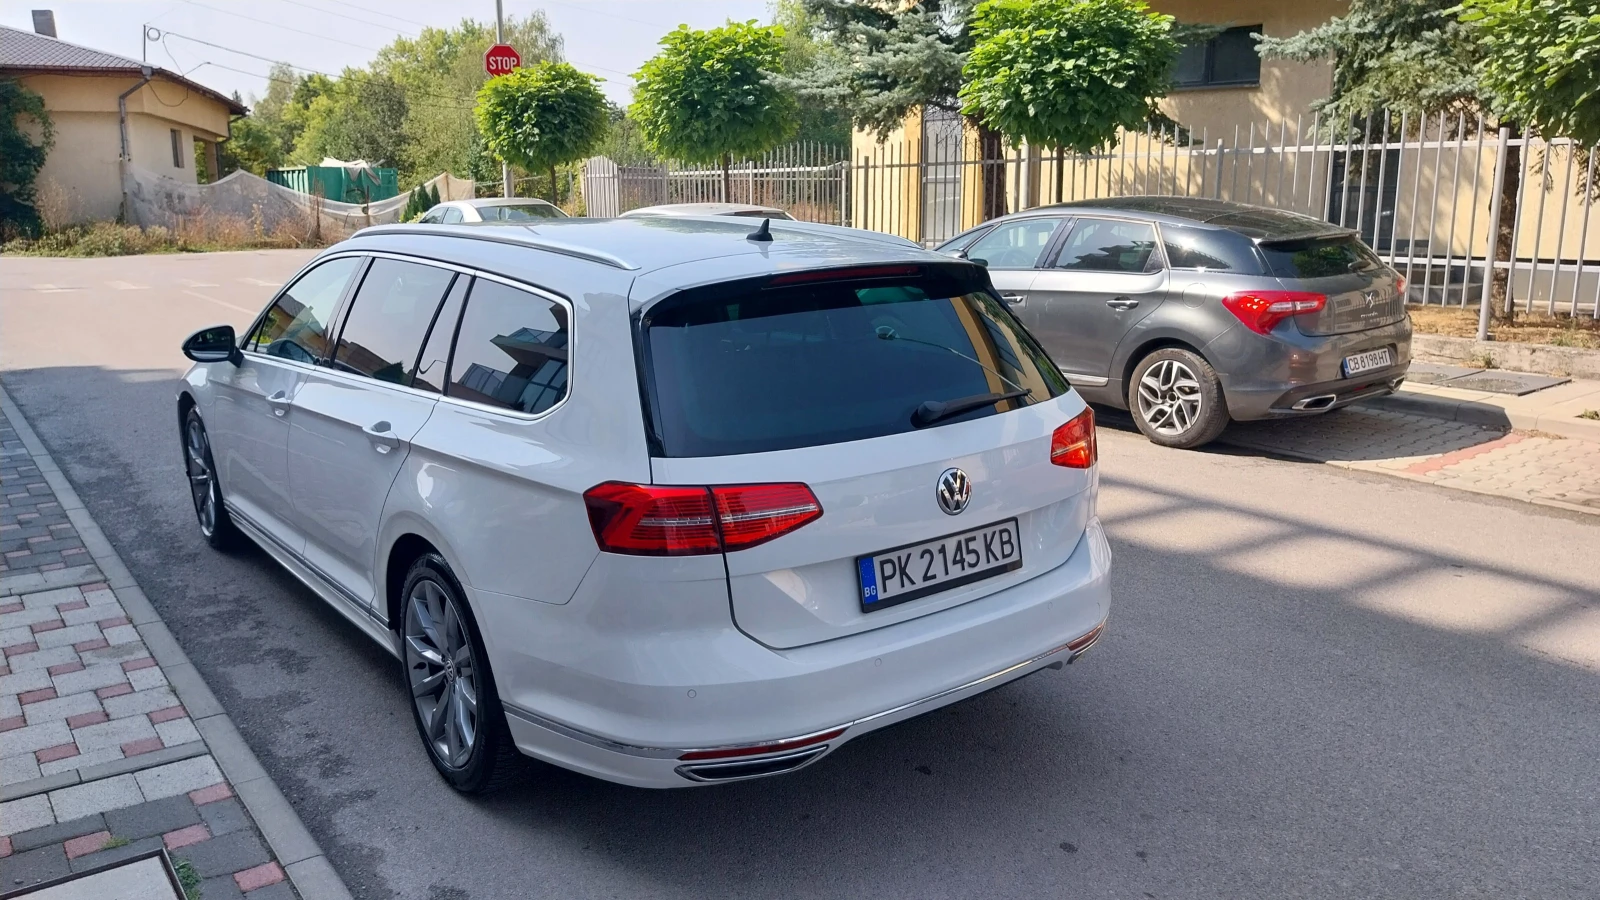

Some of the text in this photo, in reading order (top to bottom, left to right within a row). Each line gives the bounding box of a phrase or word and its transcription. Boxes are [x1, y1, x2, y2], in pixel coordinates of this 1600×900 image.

[489, 56, 517, 70] STOP
[1348, 350, 1388, 371] CB 8198 HT
[879, 527, 1015, 593] PK 2145 KB
[864, 585, 877, 597] BG
